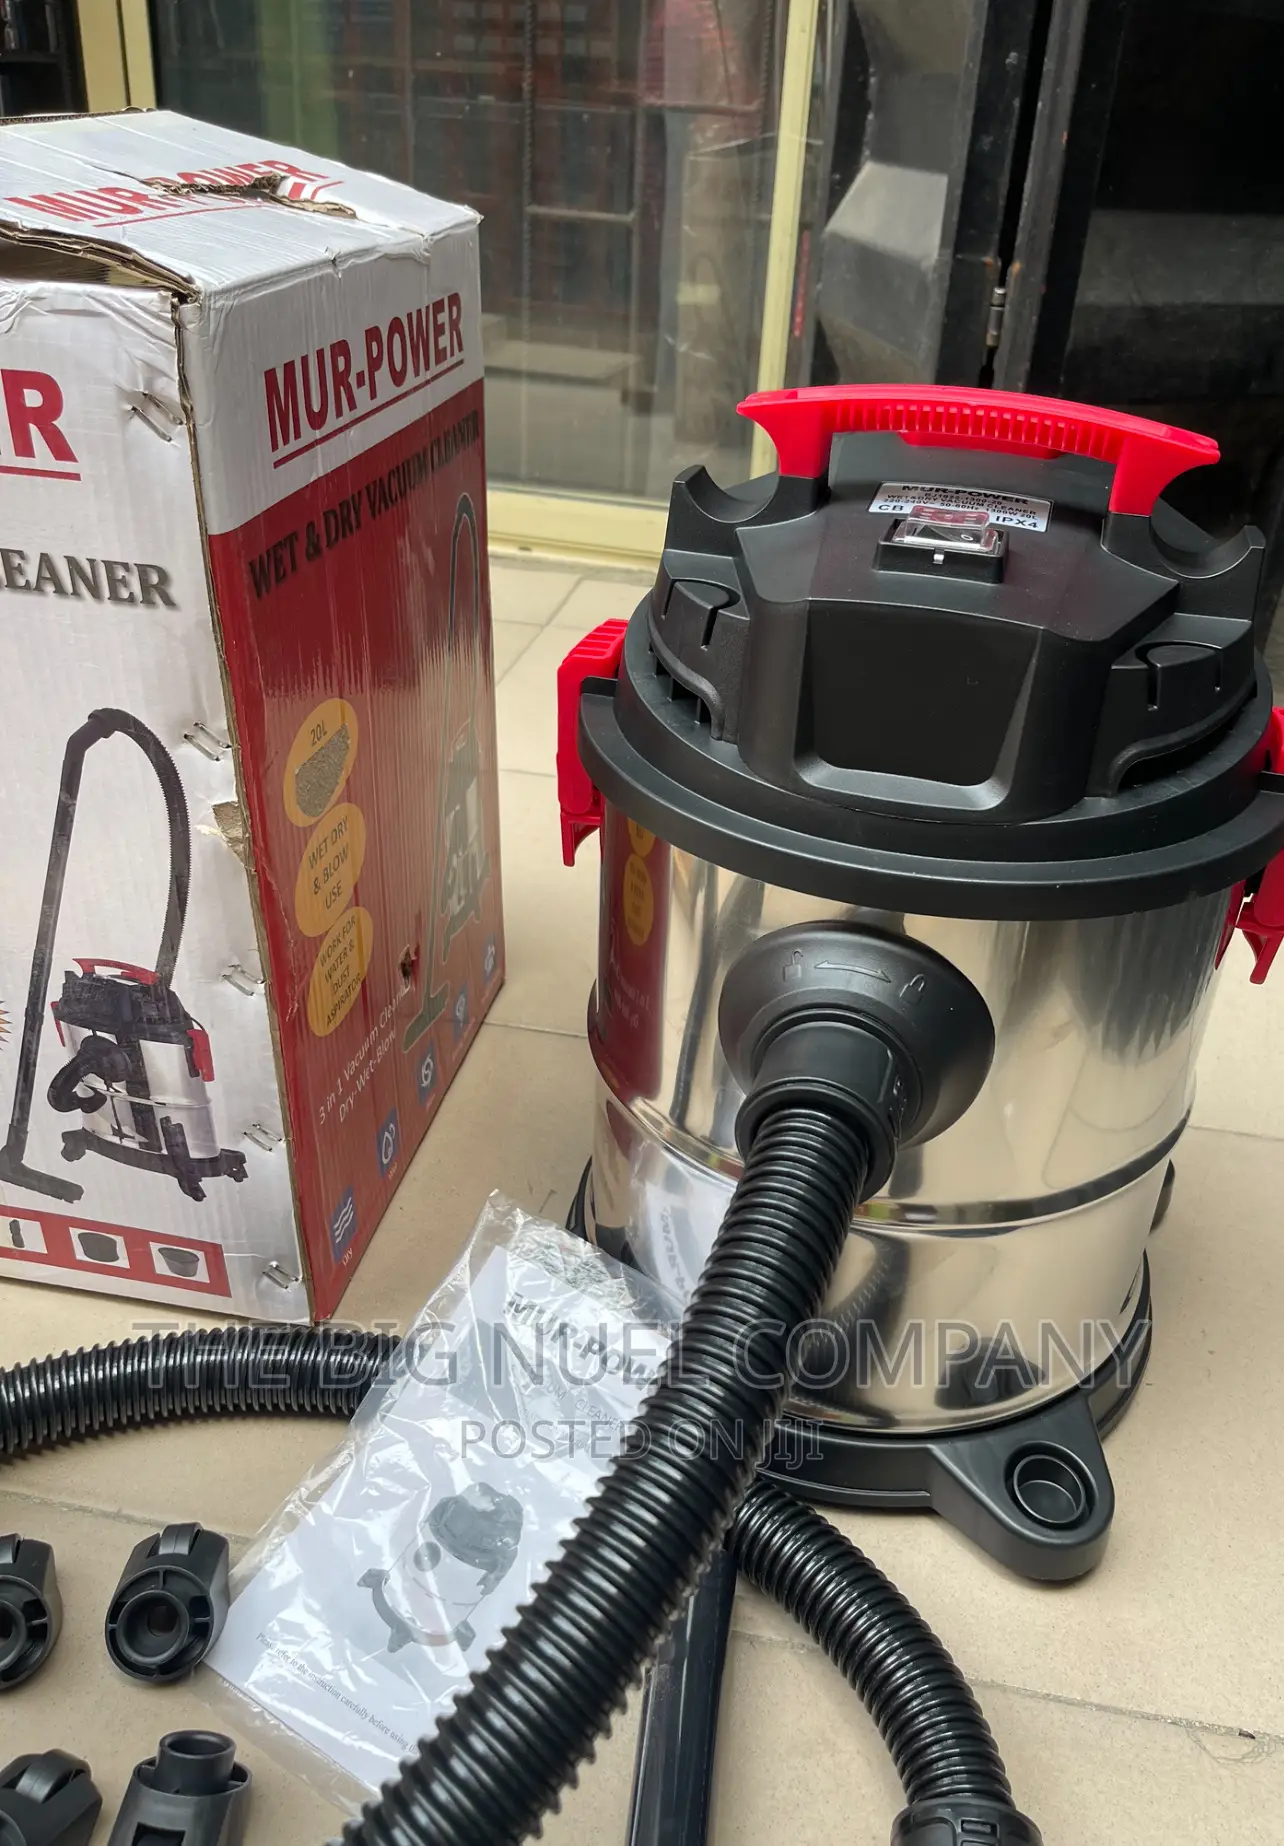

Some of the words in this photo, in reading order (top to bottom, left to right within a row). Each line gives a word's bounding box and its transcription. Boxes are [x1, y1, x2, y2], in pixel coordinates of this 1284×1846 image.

[5, 160, 330, 222] MUROWER
[264, 292, 465, 452] MUR-POWER
[249, 531, 299, 600] WET
[305, 520, 322, 562] &
[323, 490, 362, 549] DRY
[365, 445, 432, 519] VACUUM
[430, 410, 480, 473] CLEANER
[901, 485, 1029, 505] MUR-POWER
[941, 497, 985, 507] VACUUM
[987, 503, 1037, 515] CLEANER
[996, 515, 1039, 528] IPX4
[310, 719, 328, 747] 20L
[308, 836, 329, 869] WET
[330, 815, 348, 846] DRY
[313, 876, 321, 896] &
[322, 841, 349, 885] BLOW
[325, 879, 343, 910] USE
[320, 932, 342, 968] WORK
[342, 914, 356, 938] FOR
[325, 946, 349, 983] WATER
[326, 972, 362, 1029] ASPIRATOR
[332, 964, 351, 995] DUST
[319, 1106, 326, 1125] 3
[326, 1092, 336, 1113] in
[336, 1077, 343, 1096] 1
[343, 1026, 379, 1081] Vacuum
[255, 1632, 275, 1651] Pleas
[340, 1695, 368, 1720] carefully
[368, 1713, 391, 1735] before
